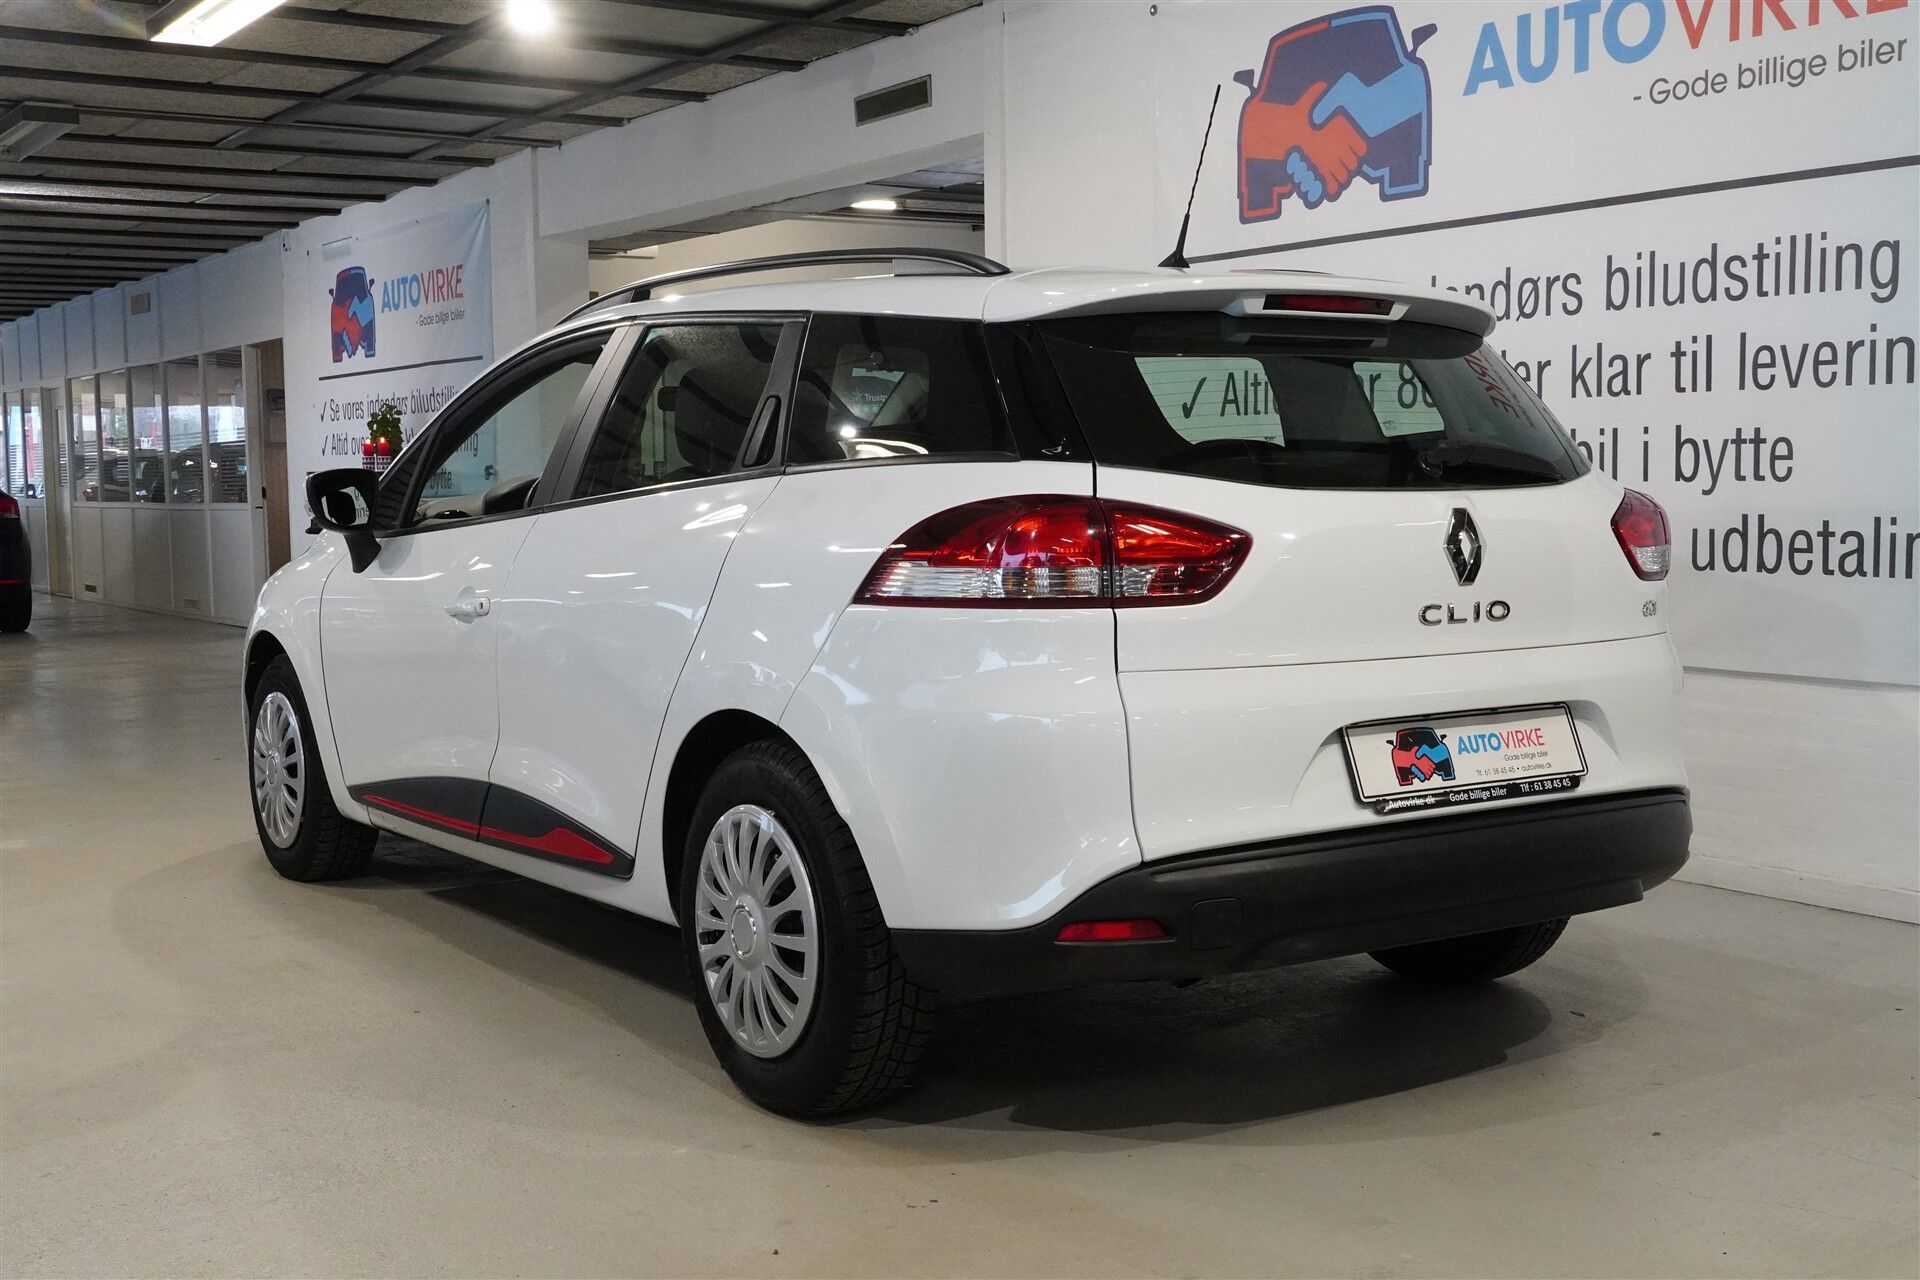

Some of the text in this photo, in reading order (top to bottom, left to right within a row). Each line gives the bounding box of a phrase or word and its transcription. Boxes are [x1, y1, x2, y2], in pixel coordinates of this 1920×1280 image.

[1462, 0, 1909, 97] AUTOVI
[1648, 69, 1728, 105] Gode
[1737, 53, 1827, 88] billige
[1838, 38, 1908, 73] biler
[1604, 231, 1901, 304] biludstilling
[380, 264, 464, 313] AUTOVIRKE
[1570, 342, 1652, 399] klar
[1669, 334, 1713, 394] til
[1738, 323, 1915, 392] leverin
[329, 398, 340, 422] Se
[341, 400, 365, 421] vores
[331, 431, 348, 456] Altid
[1674, 424, 1794, 496] bytte
[1418, 599, 1511, 626] CLIO
[1457, 727, 1545, 755] AUTOVIRKE
[1484, 767, 1491, 776] 61
[1493, 766, 1500, 774] 38
[1500, 765, 1508, 774] 45
[1508, 764, 1516, 773] 45
[1503, 754, 1520, 762] Gode
[1449, 792, 1469, 802] Gode
[1469, 788, 1491, 800] billige
[1491, 786, 1507, 797] biler
[1534, 781, 1543, 791] 61
[1543, 780, 1553, 790] 38
[1553, 779, 1562, 788] 45
[1562, 777, 1571, 787] 45
